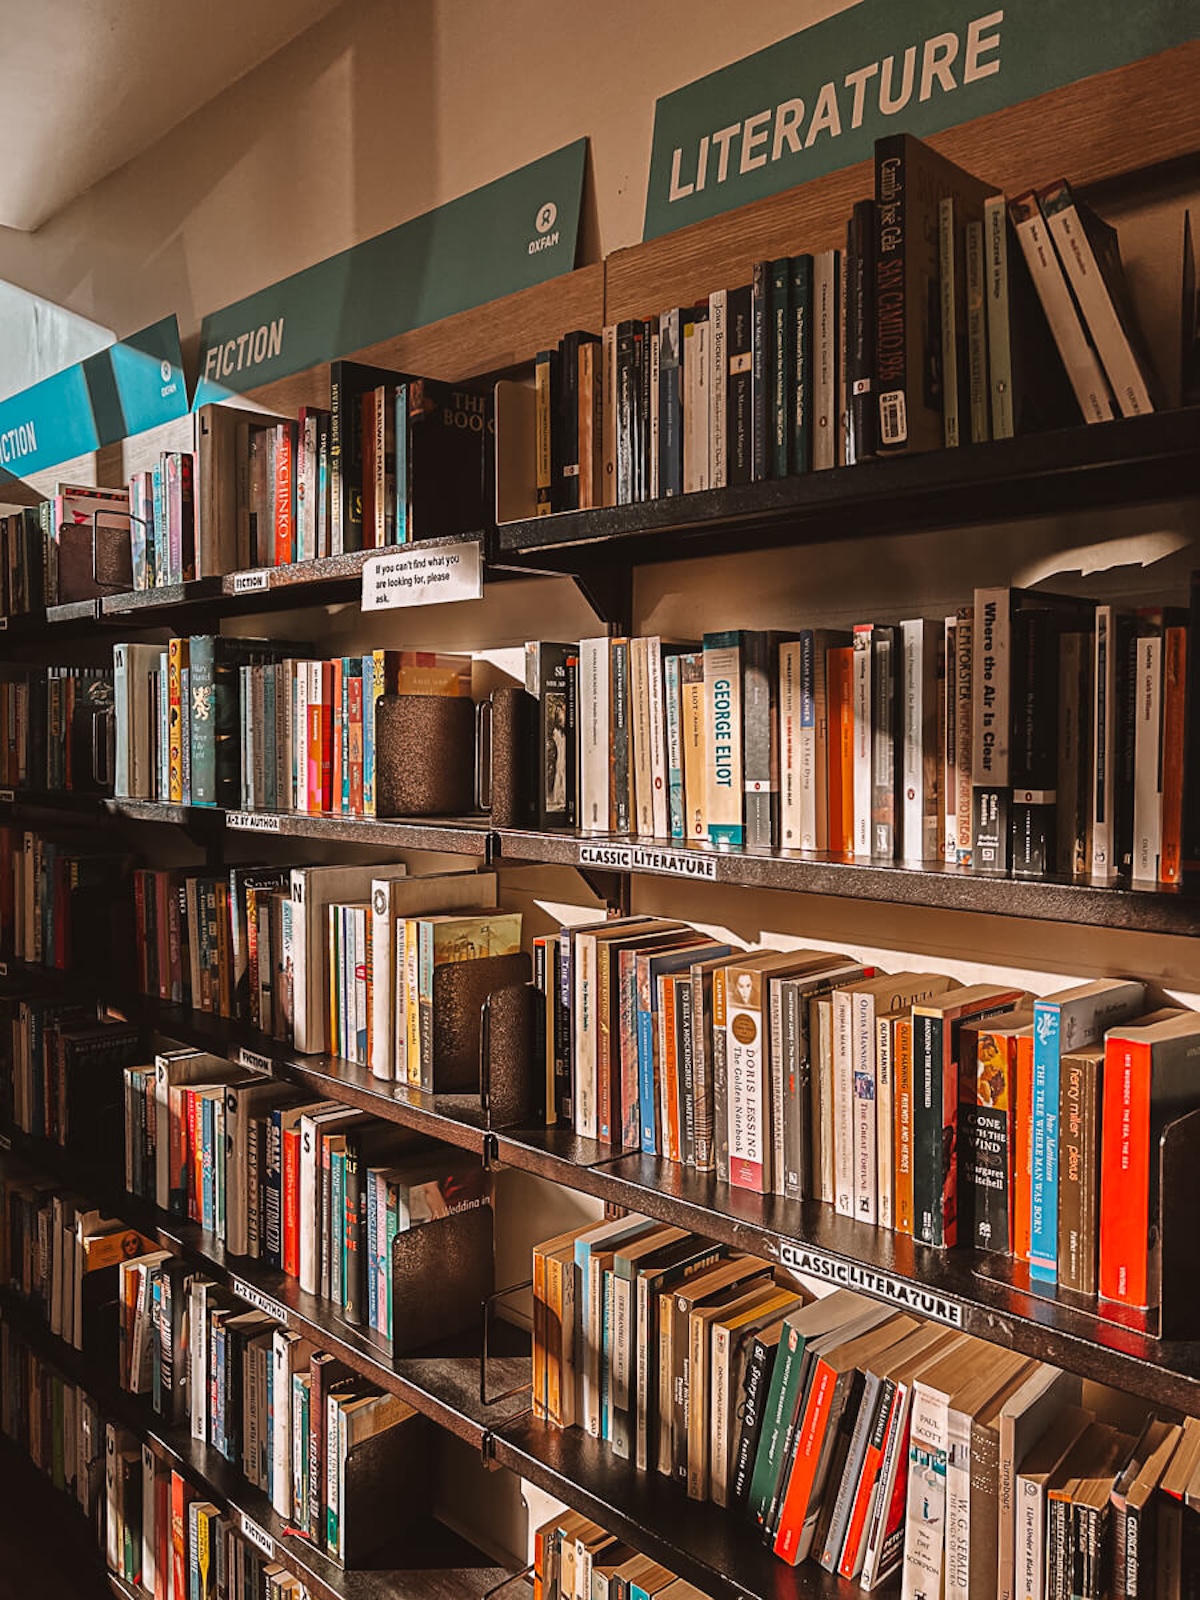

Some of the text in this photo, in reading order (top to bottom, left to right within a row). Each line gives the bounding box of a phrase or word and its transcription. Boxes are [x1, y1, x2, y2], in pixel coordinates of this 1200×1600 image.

[668, 10, 1004, 202] LITERATURE
[879, 158, 902, 253] Camilo José Cela
[528, 232, 560, 255] OXFAM
[876, 259, 903, 288] SAN
[204, 318, 285, 385] FICTION
[713, 304, 723, 371] JOHN BUCHAN
[0, 421, 37, 464] CTION
[278, 447, 290, 539] PACHINKO
[375, 555, 460, 577] If you can't find what you
[376, 571, 450, 590] are looking for, please
[235, 576, 263, 590] FICTION
[376, 593, 390, 604] ask.
[803, 638, 811, 722] WILLIAM FAULKNER
[959, 648, 972, 700] FORSTER
[982, 603, 996, 771] Where the Air Is Clear
[1144, 675, 1153, 720] Caleb Williams
[714, 680, 732, 787] GEORGE ELIOT
[802, 752, 811, 766] Lay
[959, 703, 972, 845] WHERE TREAD
[802, 769, 811, 790] Dying
[241, 817, 248, 826] BY
[251, 817, 278, 829] AUTHOR
[981, 793, 989, 826] Fuentes
[990, 793, 999, 820] Carlos
[581, 849, 713, 876] CLASSIC LITERATURE
[293, 883, 302, 903] N
[561, 960, 569, 1007] THE TURN
[681, 990, 690, 1000] TO
[423, 1010, 431, 1030] STAR
[682, 1002, 690, 1019] KILL
[860, 999, 870, 1070] OLIVIA MANNING
[243, 1052, 269, 1070] FICTION
[683, 1026, 691, 1088] MOCKINGBIRD
[880, 1023, 888, 1085] OLIVIA MANNING
[900, 1026, 909, 1089] OLIVIA MANNING
[772, 994, 780, 1151] PRIMO LEVI THE MIRROR MAKER
[685, 1094, 693, 1125] HARPER
[734, 1047, 743, 1153] The Golden Notebook
[745, 1049, 756, 1158] DORIS LESSING
[900, 1092, 910, 1173] FRIENDS AND HEROES
[988, 1130, 1007, 1143] THE
[1067, 1066, 1082, 1179] henry miller plexus
[1121, 1122, 1129, 1137] SEA,
[271, 1125, 281, 1173] SALLY
[303, 1132, 311, 1153] S
[860, 1102, 872, 1191] THE GREAT FORTUNE
[1034, 1062, 1045, 1232] THE TREE WHERE MAN WAS BORN
[1047, 1111, 1056, 1180] Peter Matthiessen
[248, 1126, 256, 1242] KILEY REID
[266, 1184, 280, 1253] INTERMEZZO
[782, 1247, 958, 1322] CLASSIC LITERATURE
[1118, 1265, 1126, 1293] VINTAGE
[259, 1297, 285, 1320] AUTHOR
[161, 1365, 172, 1391] JAZZ
[746, 1366, 761, 1397] Story
[781, 1355, 792, 1385] DOROTHY
[744, 1414, 755, 1427] O
[745, 1398, 757, 1412] of
[776, 1387, 787, 1424] RICHARDSON
[873, 1404, 888, 1445] SALINGER
[916, 1426, 942, 1445] SCOTT
[919, 1414, 939, 1431] PAUL
[739, 1438, 750, 1469] Pauline
[1003, 1459, 1011, 1509] Turnabout
[1025, 1511, 1034, 1525] Live
[1087, 1511, 1096, 1556] the reprieve
[246, 1521, 271, 1551] FICTION
[949, 1493, 957, 1587] THE RINGS OF SATURN
[957, 1499, 968, 1588] W. G. SEBALD
[1025, 1528, 1034, 1549] Under
[906, 1554, 939, 1577] SCORPION
[1025, 1557, 1034, 1576] Black
[1126, 1516, 1138, 1597] GEORGE STEINER
[1025, 1577, 1034, 1592] Sun
